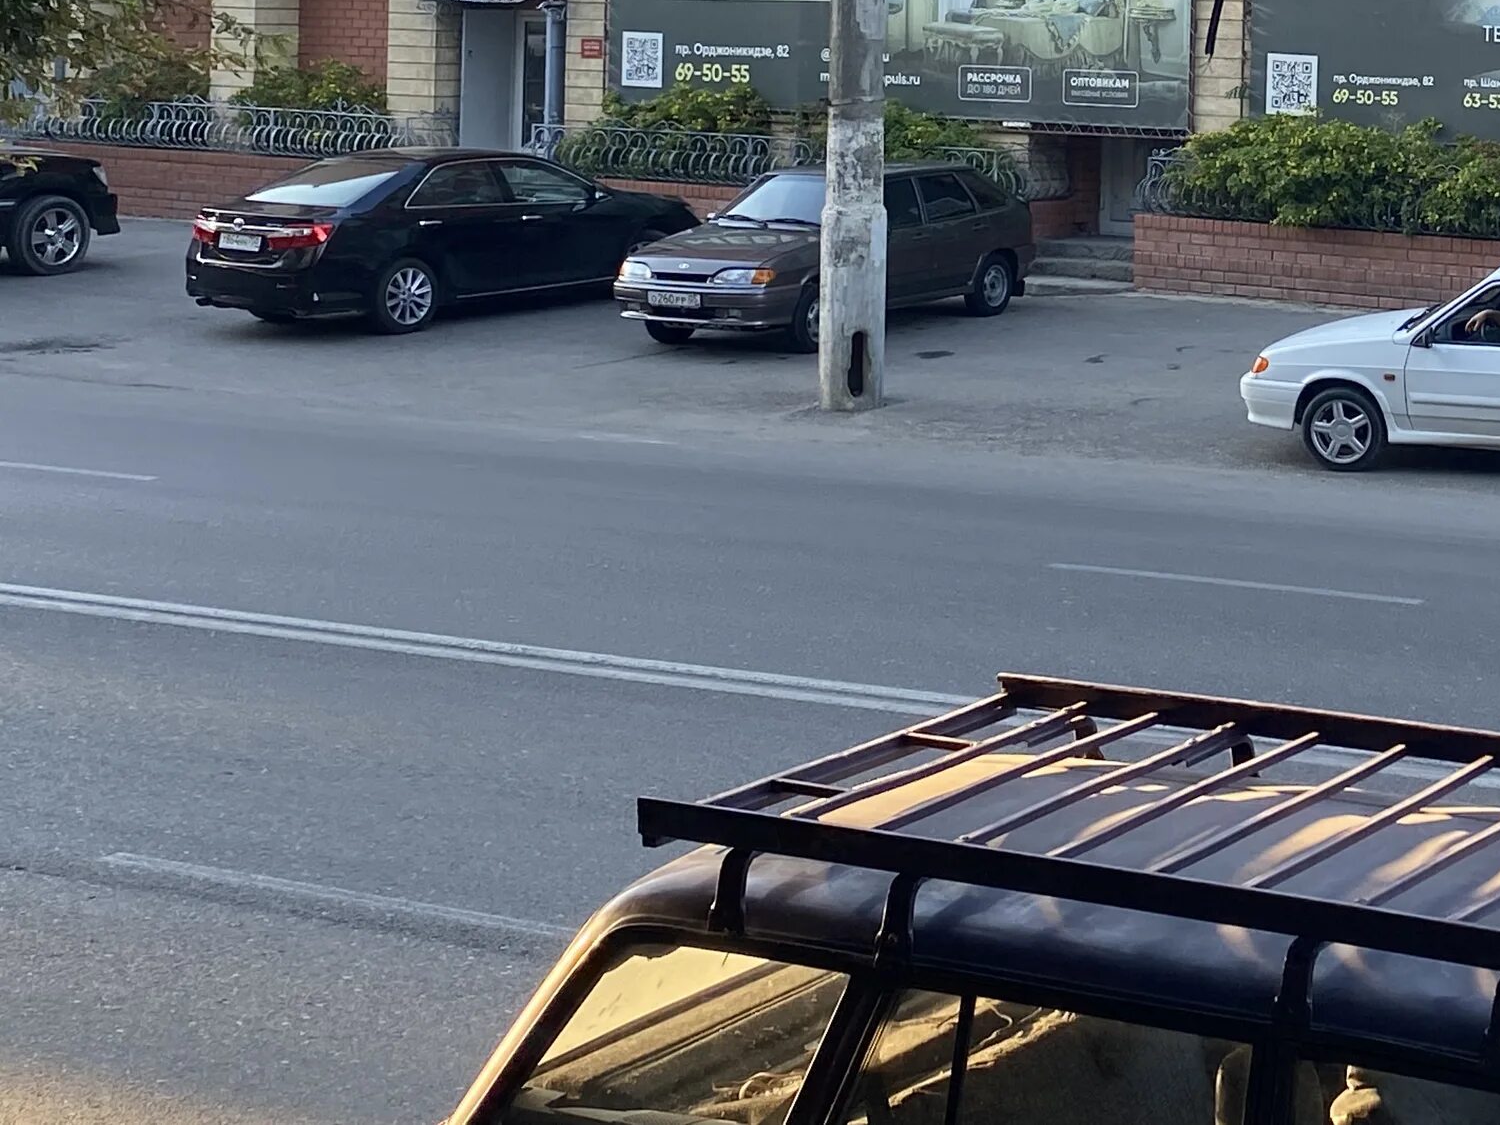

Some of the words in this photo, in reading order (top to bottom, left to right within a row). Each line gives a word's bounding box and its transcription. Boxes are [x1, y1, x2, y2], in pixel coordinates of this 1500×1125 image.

[675, 44, 692, 56] пр.
[694, 43, 774, 59] Орджоникидзе,
[776, 45, 790, 58] 82
[675, 63, 750, 83] 69-50-55
[967, 72, 1022, 84] РАССРОЧКА
[1070, 77, 1129, 89] ОПТОВИКАМ
[1333, 74, 1347, 85] пр.
[1422, 76, 1434, 86] 82
[1464, 78, 1478, 89] пр.
[1332, 88, 1398, 106] 69-50-55
